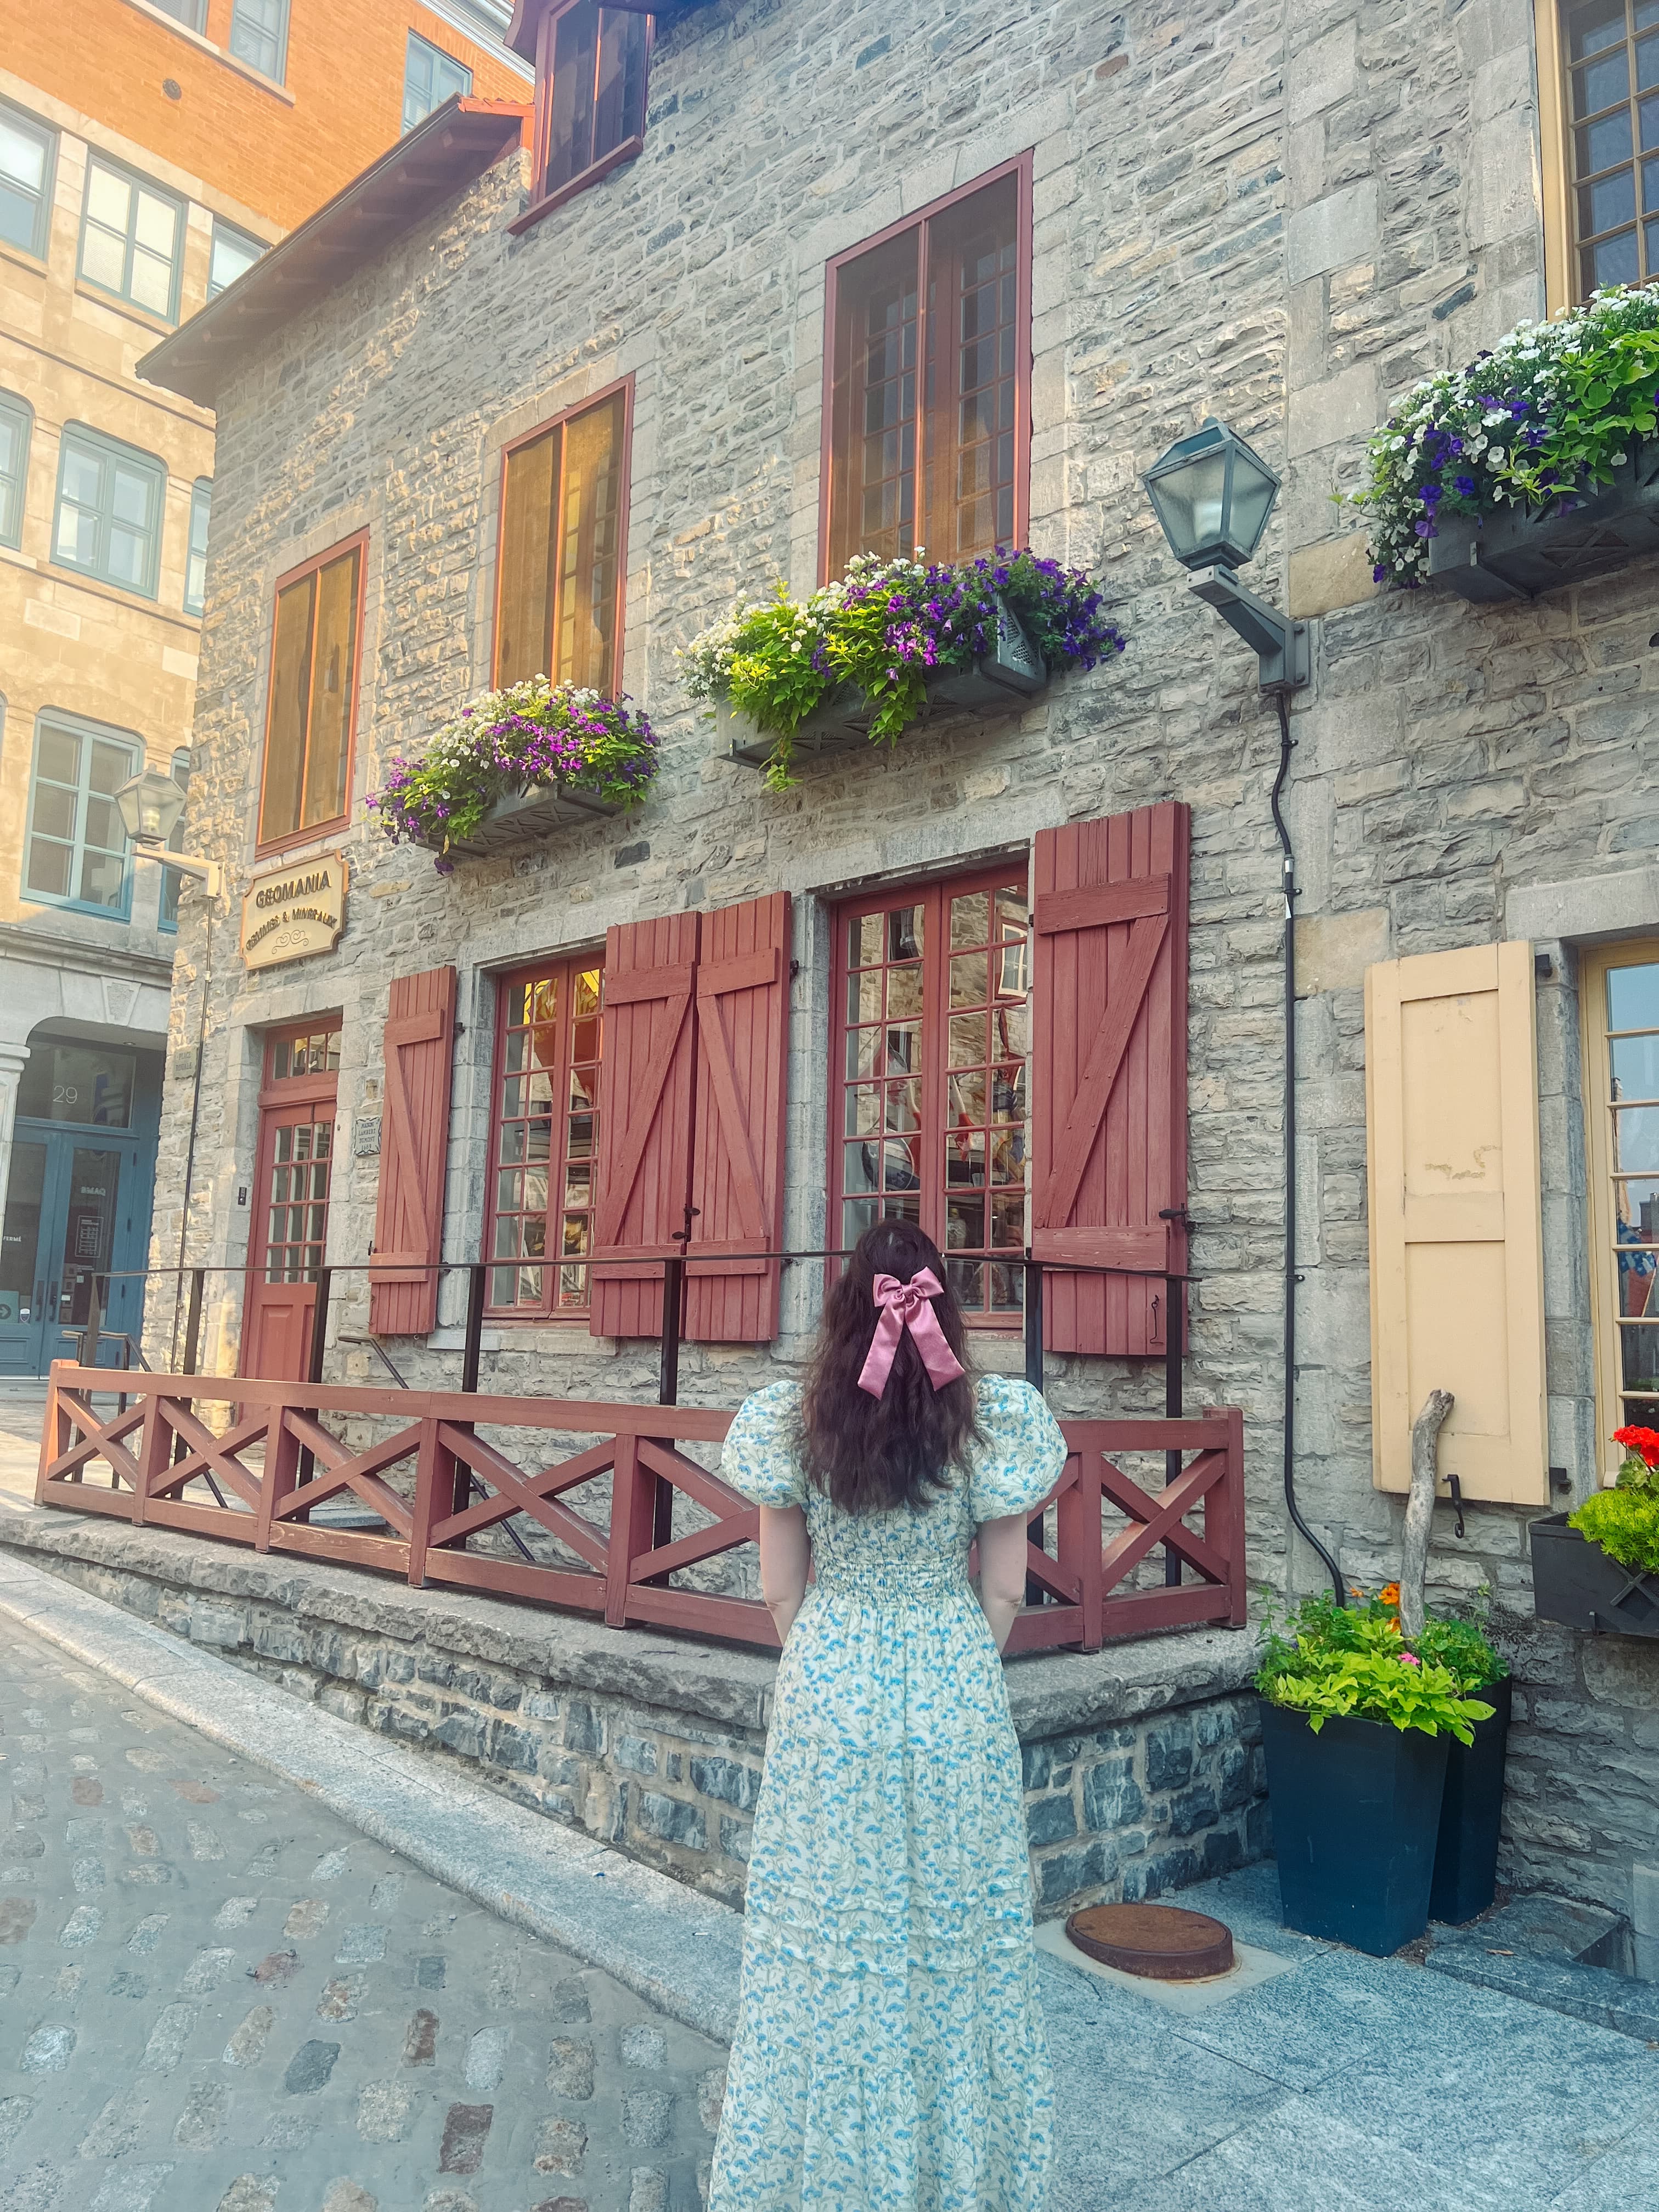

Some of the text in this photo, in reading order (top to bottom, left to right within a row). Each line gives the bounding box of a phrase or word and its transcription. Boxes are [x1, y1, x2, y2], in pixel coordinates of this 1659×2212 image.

[256, 870, 332, 909] GEOMANIA
[246, 907, 338, 951] GEMMES & MINERAUX
[53, 1085, 77, 1104] 29
